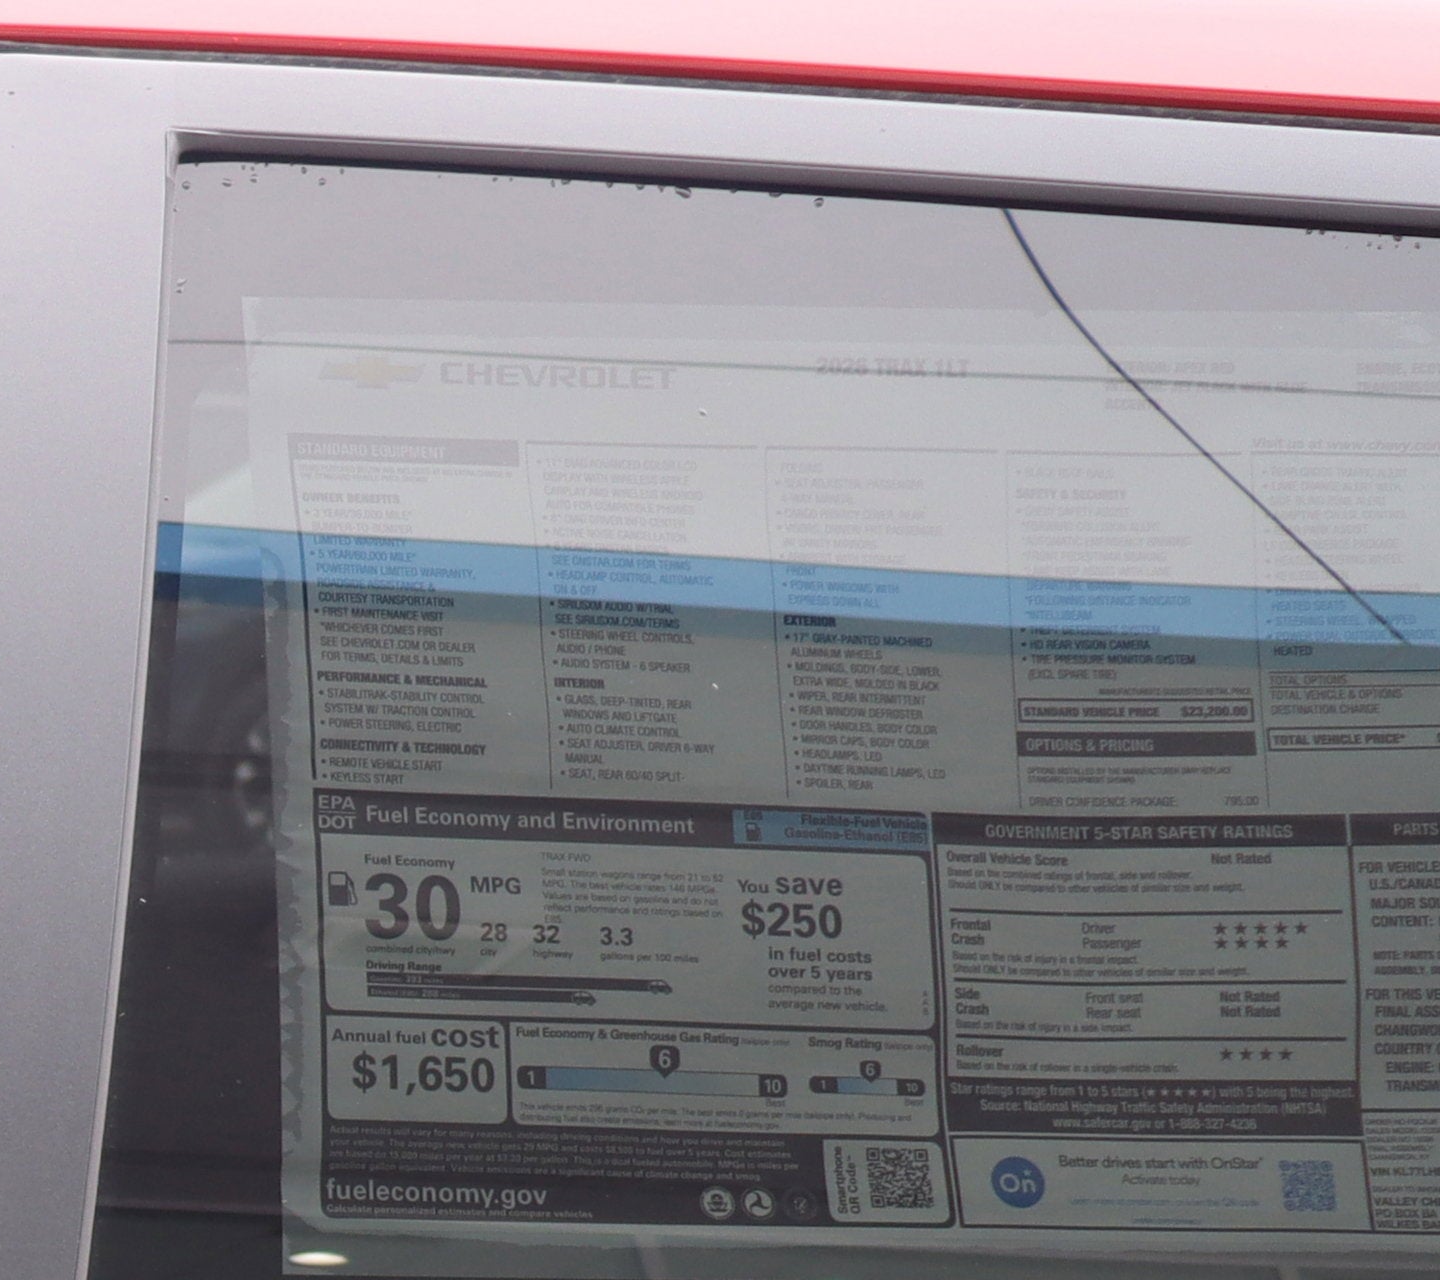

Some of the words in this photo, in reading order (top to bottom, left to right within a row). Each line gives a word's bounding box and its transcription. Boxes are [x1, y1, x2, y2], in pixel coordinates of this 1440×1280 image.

[440, 361, 675, 390] CHEVROLET
[297, 442, 367, 457] STANDARD
[371, 444, 446, 459] EQUIPMENT
[319, 592, 367, 604] COURTESY
[371, 595, 454, 607] TRANSPORTATION
[322, 607, 348, 618] FIRST
[351, 609, 418, 621] MAINTENANCE
[421, 612, 444, 622] VISIT
[783, 614, 836, 627] EXTERIOR
[317, 671, 400, 684] PERFORMANCE
[404, 674, 412, 684] &
[416, 675, 487, 688] MECHANICAL
[554, 677, 604, 689] INTERIOR
[1024, 707, 1079, 717] STANDARD
[1083, 707, 1125, 717] VEHICLE
[1129, 707, 1159, 717] PRICE
[1026, 739, 1082, 751] OPTIONS
[1086, 740, 1095, 751] &
[1100, 740, 1154, 751] PRICING
[1273, 735, 1309, 745] TOTAL
[1313, 734, 1362, 745] VEHICLE
[320, 739, 398, 752] CONNECTIVITY
[402, 742, 410, 752] &
[414, 742, 486, 755] TECHNOLOGY
[330, 757, 369, 768] REMOTE
[371, 759, 409, 770] VEHICLE
[412, 760, 442, 770] START
[330, 772, 371, 783] KEYLESS
[374, 774, 404, 784] START
[319, 795, 355, 810] EPA
[319, 816, 356, 829] DOT
[366, 806, 408, 824] Fuel
[416, 808, 510, 830] Economy
[518, 812, 556, 829] and
[563, 813, 694, 834] Environment
[801, 814, 881, 828] Flexible-Fuel
[883, 817, 927, 830] Vehicle
[784, 828, 893, 843] Gasoline-Ethanol
[985, 824, 1090, 840] GOVERNMENT
[1094, 826, 1152, 840] 5-STAR
[1158, 825, 1218, 839] SAFETY
[1223, 825, 1293, 839] RATINGS
[1393, 823, 1439, 836] PARTS
[364, 853, 391, 866] Fuel
[396, 855, 455, 870] Economy
[947, 850, 986, 863] Overall
[989, 852, 1031, 865] Vehicle
[1035, 854, 1068, 866] Score
[1211, 853, 1232, 864] Not
[1236, 853, 1272, 864] Rated
[738, 880, 769, 894] You
[776, 877, 842, 897] save
[364, 872, 460, 940] 30
[470, 876, 522, 894] MPG
[742, 899, 842, 940] $250
[950, 918, 991, 931] Frontal
[480, 922, 508, 942] 28
[532, 924, 560, 944] 32
[600, 926, 633, 946] 3.3
[1081, 922, 1116, 934] Driver
[951, 933, 985, 945] Crash
[1082, 937, 1142, 951] Passenger
[366, 945, 413, 954] combined
[532, 950, 572, 960] highway
[769, 947, 784, 961] in
[789, 948, 821, 962] fuel
[826, 950, 872, 965] costs
[600, 951, 634, 962] gallons
[637, 953, 651, 963] per
[655, 953, 671, 962] 100
[673, 954, 699, 963] miles
[366, 960, 404, 972] Driving
[408, 961, 442, 972] Range
[768, 967, 806, 979] over
[811, 966, 821, 980] 5
[826, 968, 873, 982] years
[768, 984, 827, 997] compared
[830, 985, 842, 996] to
[844, 986, 862, 997] the
[955, 988, 980, 1000] Side
[1086, 991, 1115, 1004] Front
[1119, 993, 1143, 1004] seat
[1219, 991, 1241, 1002] Not
[1245, 991, 1280, 1002] Rated
[768, 999, 821, 1012] average
[824, 1002, 842, 1012] new
[956, 1003, 989, 1016] Crash
[1220, 1006, 1241, 1017] Not
[1245, 1006, 1280, 1017] Rated
[1086, 1007, 1114, 1019] Rear
[1117, 1008, 1142, 1019] seat
[332, 1028, 391, 1043] Annual
[396, 1030, 426, 1044] fuel
[431, 1026, 499, 1048] cost
[516, 1027, 540, 1038] Fuel
[542, 1028, 595, 1041] Economy
[598, 1029, 607, 1039] &
[610, 1029, 677, 1042] Greenhouse
[680, 1032, 701, 1043] Gas
[703, 1032, 739, 1047] Rating
[808, 1036, 842, 1050] Smog
[845, 1037, 882, 1051] Rating
[956, 1044, 1003, 1057] Rollover
[658, 1050, 671, 1068] 6
[352, 1050, 495, 1096] $1,650
[865, 1063, 876, 1076] 6
[527, 1071, 535, 1085] 1
[764, 1079, 781, 1093] 10
[821, 1080, 826, 1090] 1
[906, 1083, 918, 1092] 10
[980, 1100, 1021, 1112] Source:
[1024, 1101, 1069, 1113] National
[1072, 1102, 1119, 1115] Highway
[1160, 1103, 1194, 1115] Safety
[1197, 1102, 1278, 1114] Administration
[1282, 1102, 1327, 1116] (NHTSA)
[1052, 1118, 1151, 1131] www.safercar.gov
[1155, 1120, 1165, 1129] or
[1059, 1155, 1098, 1168] Better
[1102, 1156, 1143, 1170] drives
[1145, 1158, 1175, 1170] start
[1178, 1157, 1207, 1170] with
[835, 1147, 848, 1214] Smartphone
[1000, 1173, 1037, 1194] On
[1122, 1174, 1166, 1186] Activate
[1168, 1176, 1200, 1186] today
[326, 1177, 547, 1210] fueleconomy.gov
[850, 1195, 861, 1214] QR
